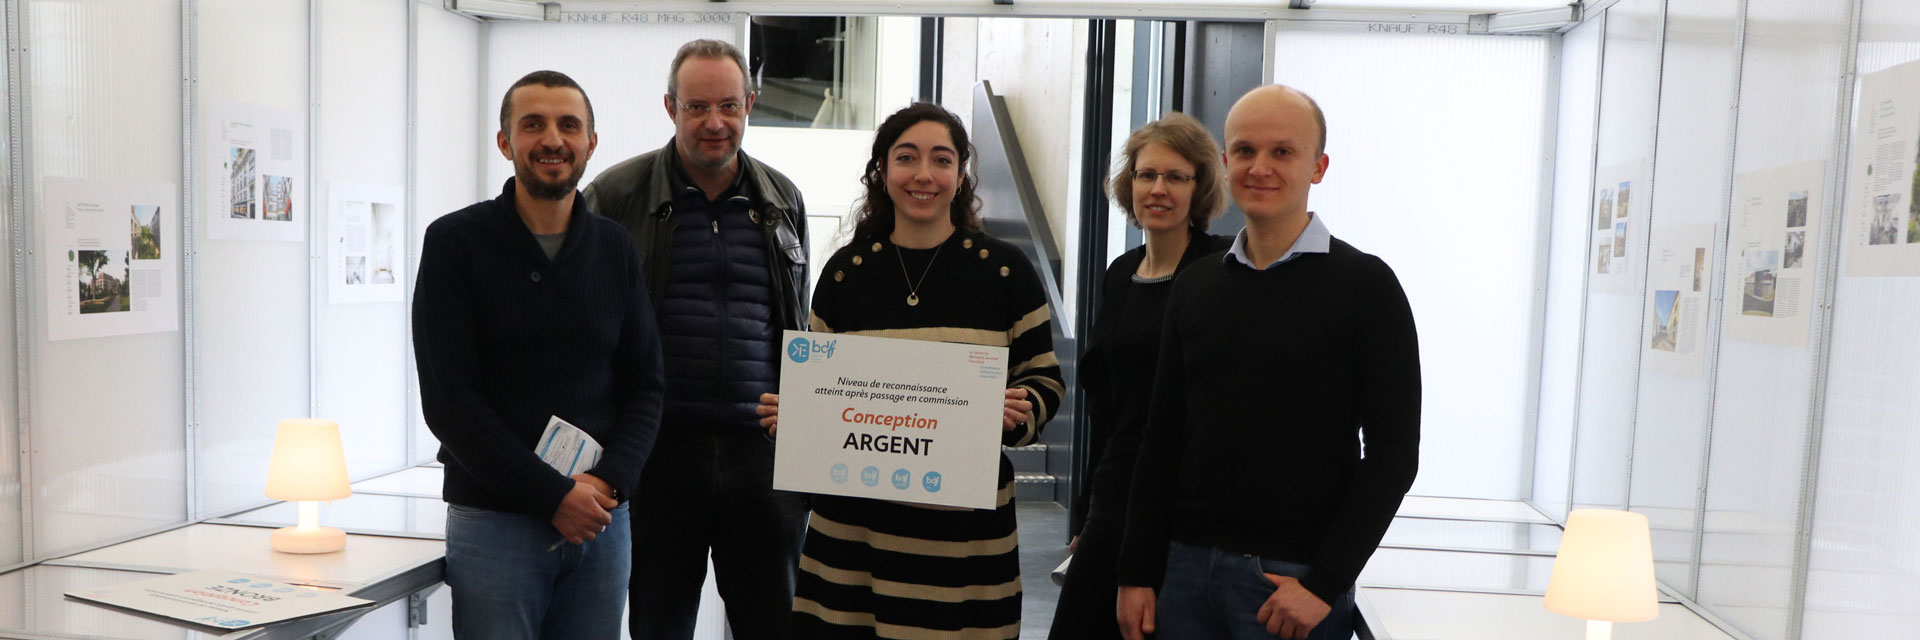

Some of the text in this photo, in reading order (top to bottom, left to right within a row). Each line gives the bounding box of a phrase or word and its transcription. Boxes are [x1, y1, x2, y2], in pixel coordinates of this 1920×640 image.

[567, 13, 610, 23] KNAUF
[621, 13, 649, 23] R48
[657, 13, 685, 23] MAG
[1368, 23, 1458, 34] KNAUF R48
[812, 339, 837, 359] bdf
[837, 376, 948, 394] Niveau de reconnaissance
[815, 387, 843, 396] atteint
[845, 389, 869, 399] après
[869, 392, 905, 403] passage
[918, 396, 969, 407] commission
[841, 407, 938, 431] Conception
[843, 432, 933, 456] ARGENT
[183, 589, 259, 606] Conception
[205, 585, 282, 601] BRONZE
